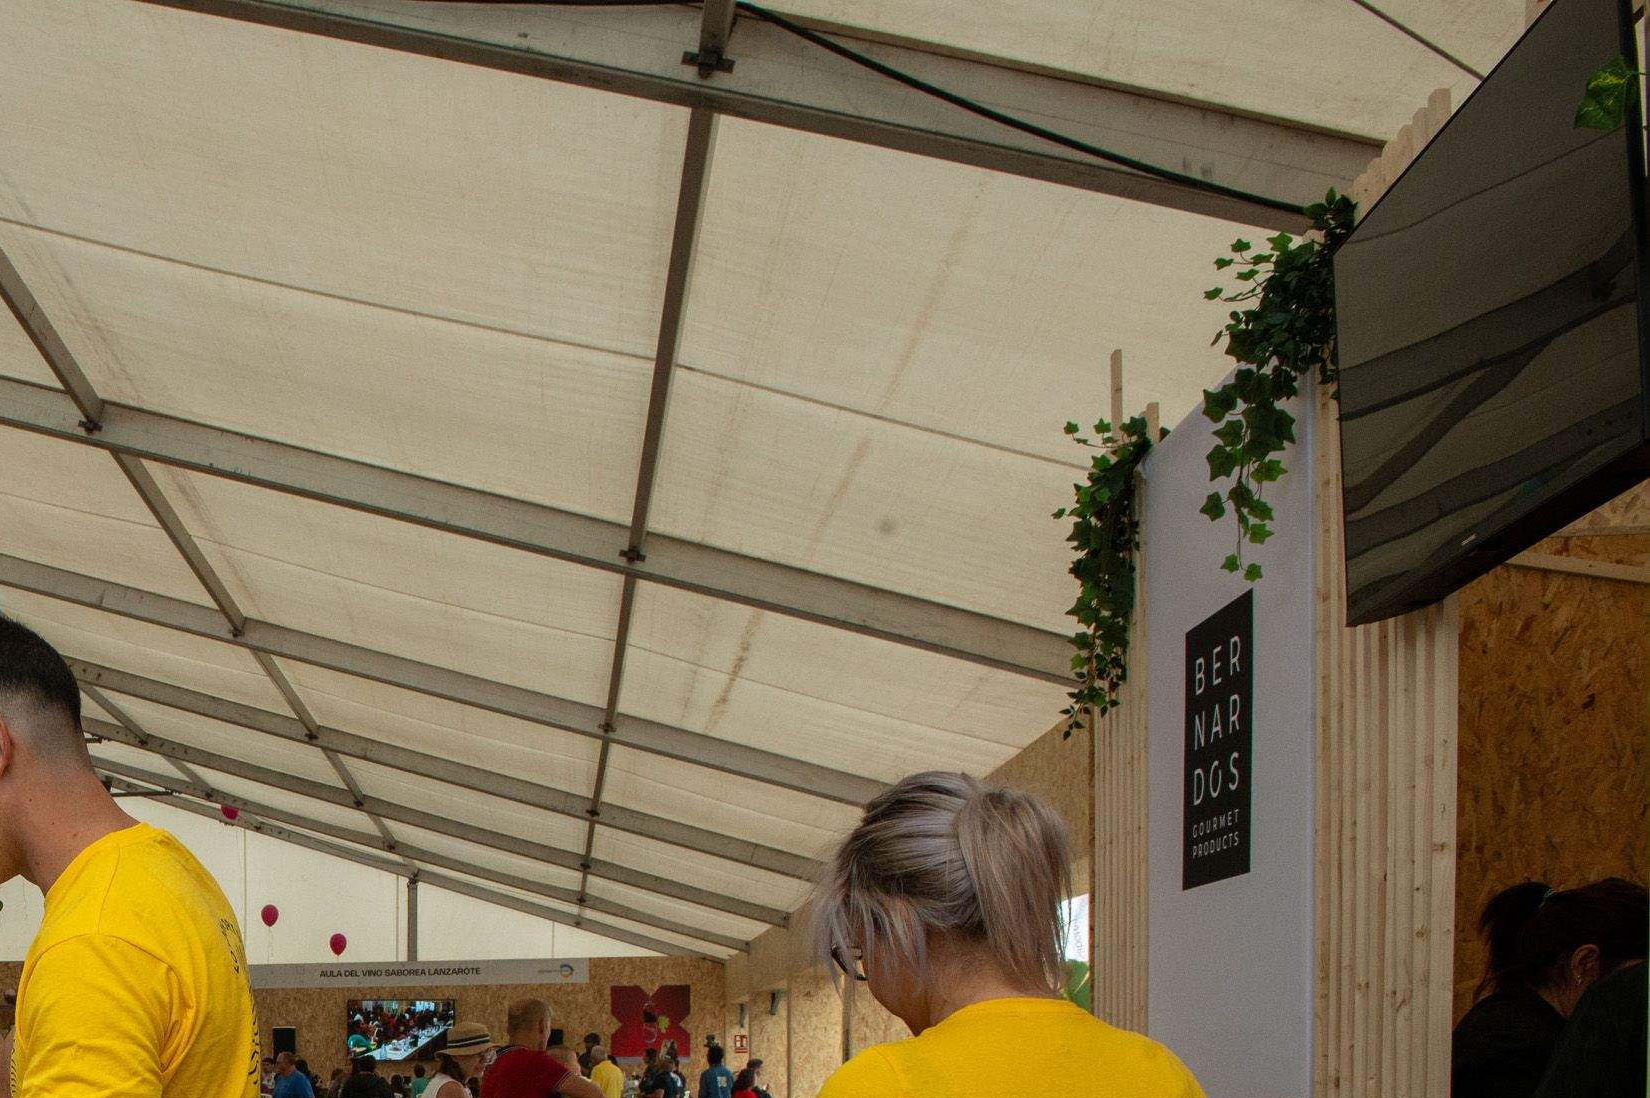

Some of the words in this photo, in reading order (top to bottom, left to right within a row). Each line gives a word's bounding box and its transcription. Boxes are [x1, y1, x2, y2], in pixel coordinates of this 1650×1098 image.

[1195, 635, 1241, 696] BER
[1194, 693, 1240, 750] NAR
[1193, 751, 1239, 806] DOS
[1192, 808, 1239, 839] GOURMET
[1192, 831, 1239, 860] PRODUCTS
[319, 969, 342, 978] AULA
[344, 969, 360, 978] DEL
[361, 968, 383, 978] VINO
[384, 968, 427, 977] SABOREA
[428, 967, 481, 977] LANZAROTE
